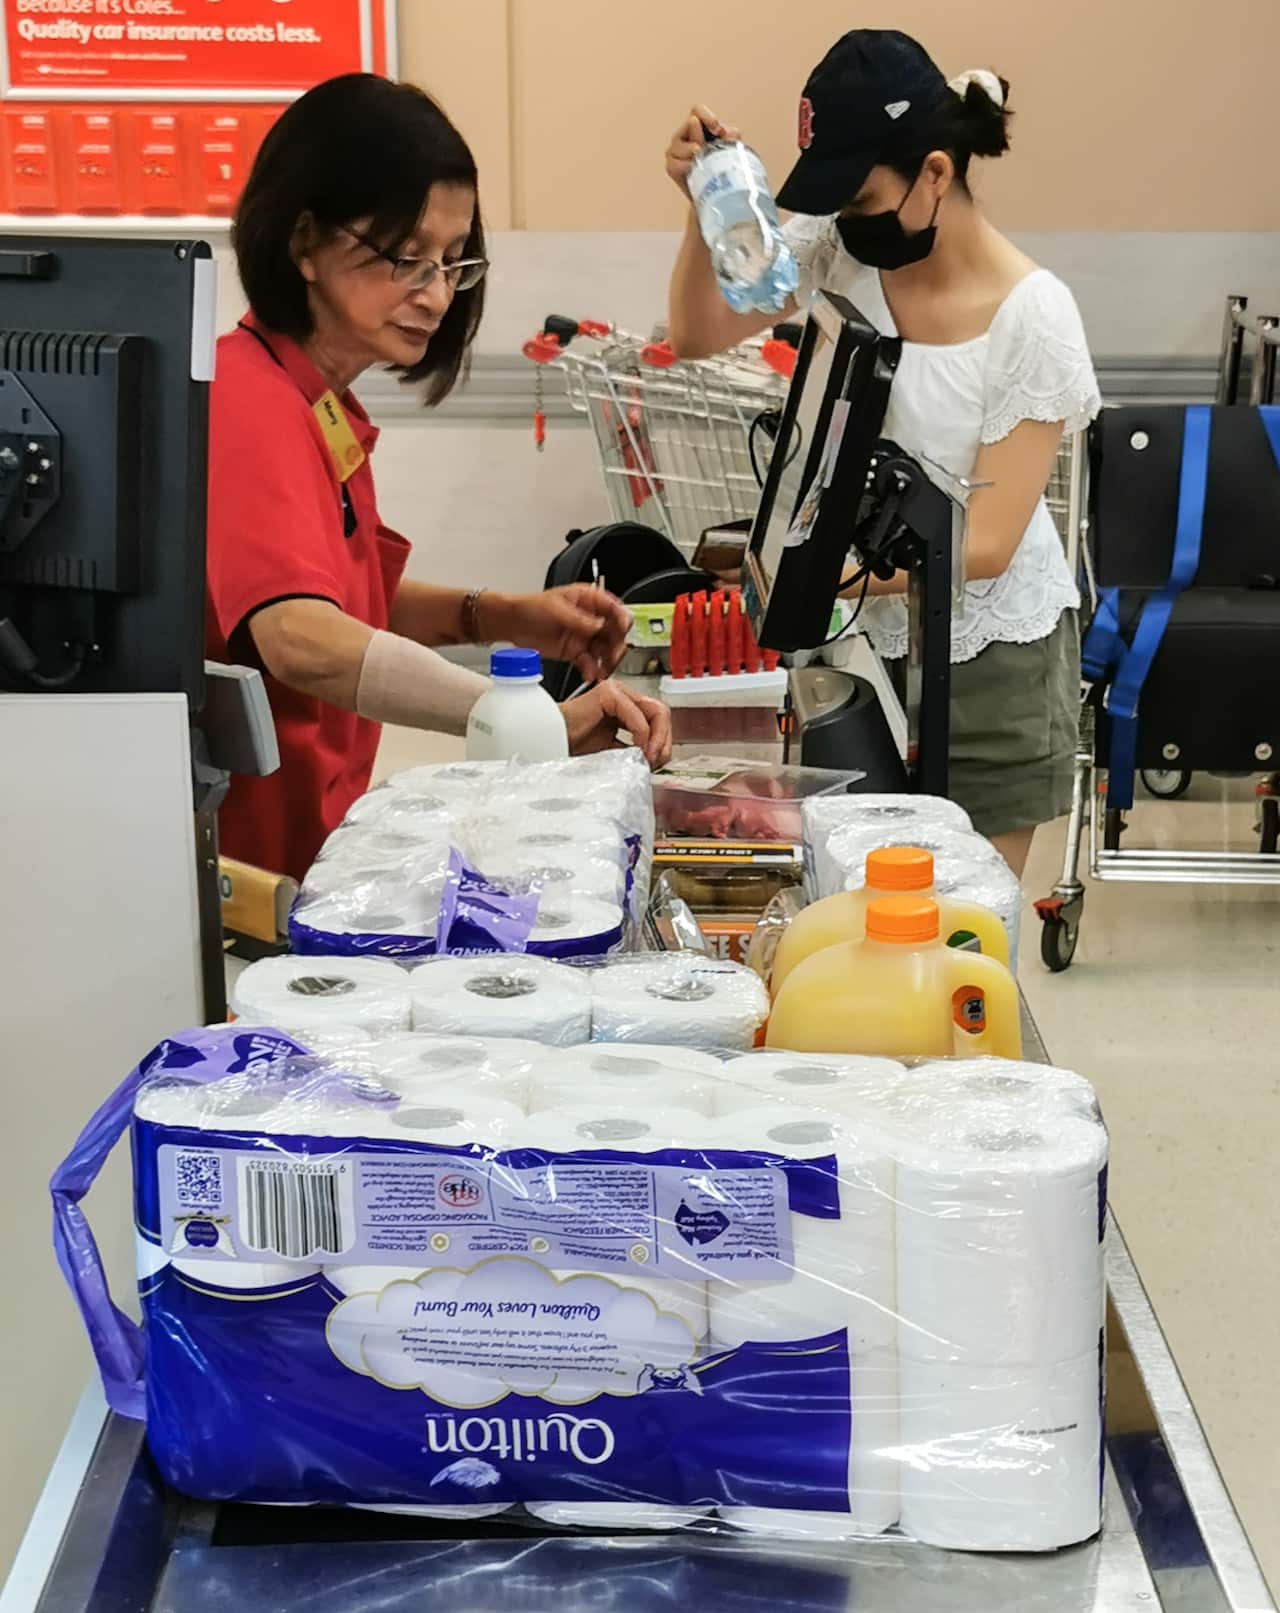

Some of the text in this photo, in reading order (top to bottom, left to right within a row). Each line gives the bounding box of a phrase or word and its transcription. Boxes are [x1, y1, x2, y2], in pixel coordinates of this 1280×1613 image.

[16, 0, 92, 13] Because
[17, 19, 321, 43] Quality car insurance costs less.
[413, 1301, 601, 1322] Quilton Loves Your Bum!
[426, 1413, 615, 1465] Quilton
